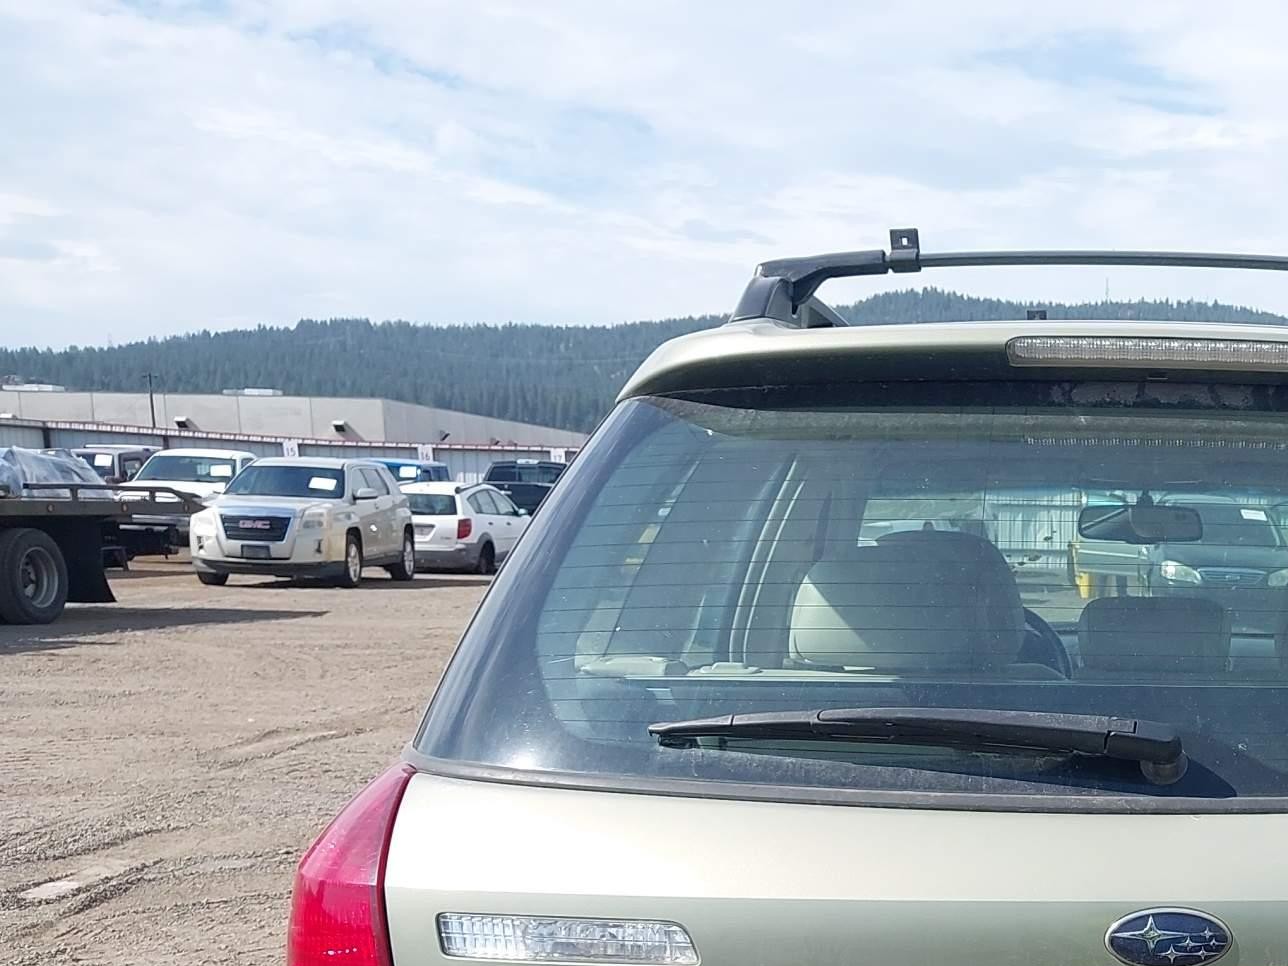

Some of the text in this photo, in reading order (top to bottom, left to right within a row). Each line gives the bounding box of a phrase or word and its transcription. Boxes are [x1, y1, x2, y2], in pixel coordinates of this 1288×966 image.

[285, 447, 297, 457] 15
[420, 450, 431, 461] 16
[239, 519, 271, 530] GMC
